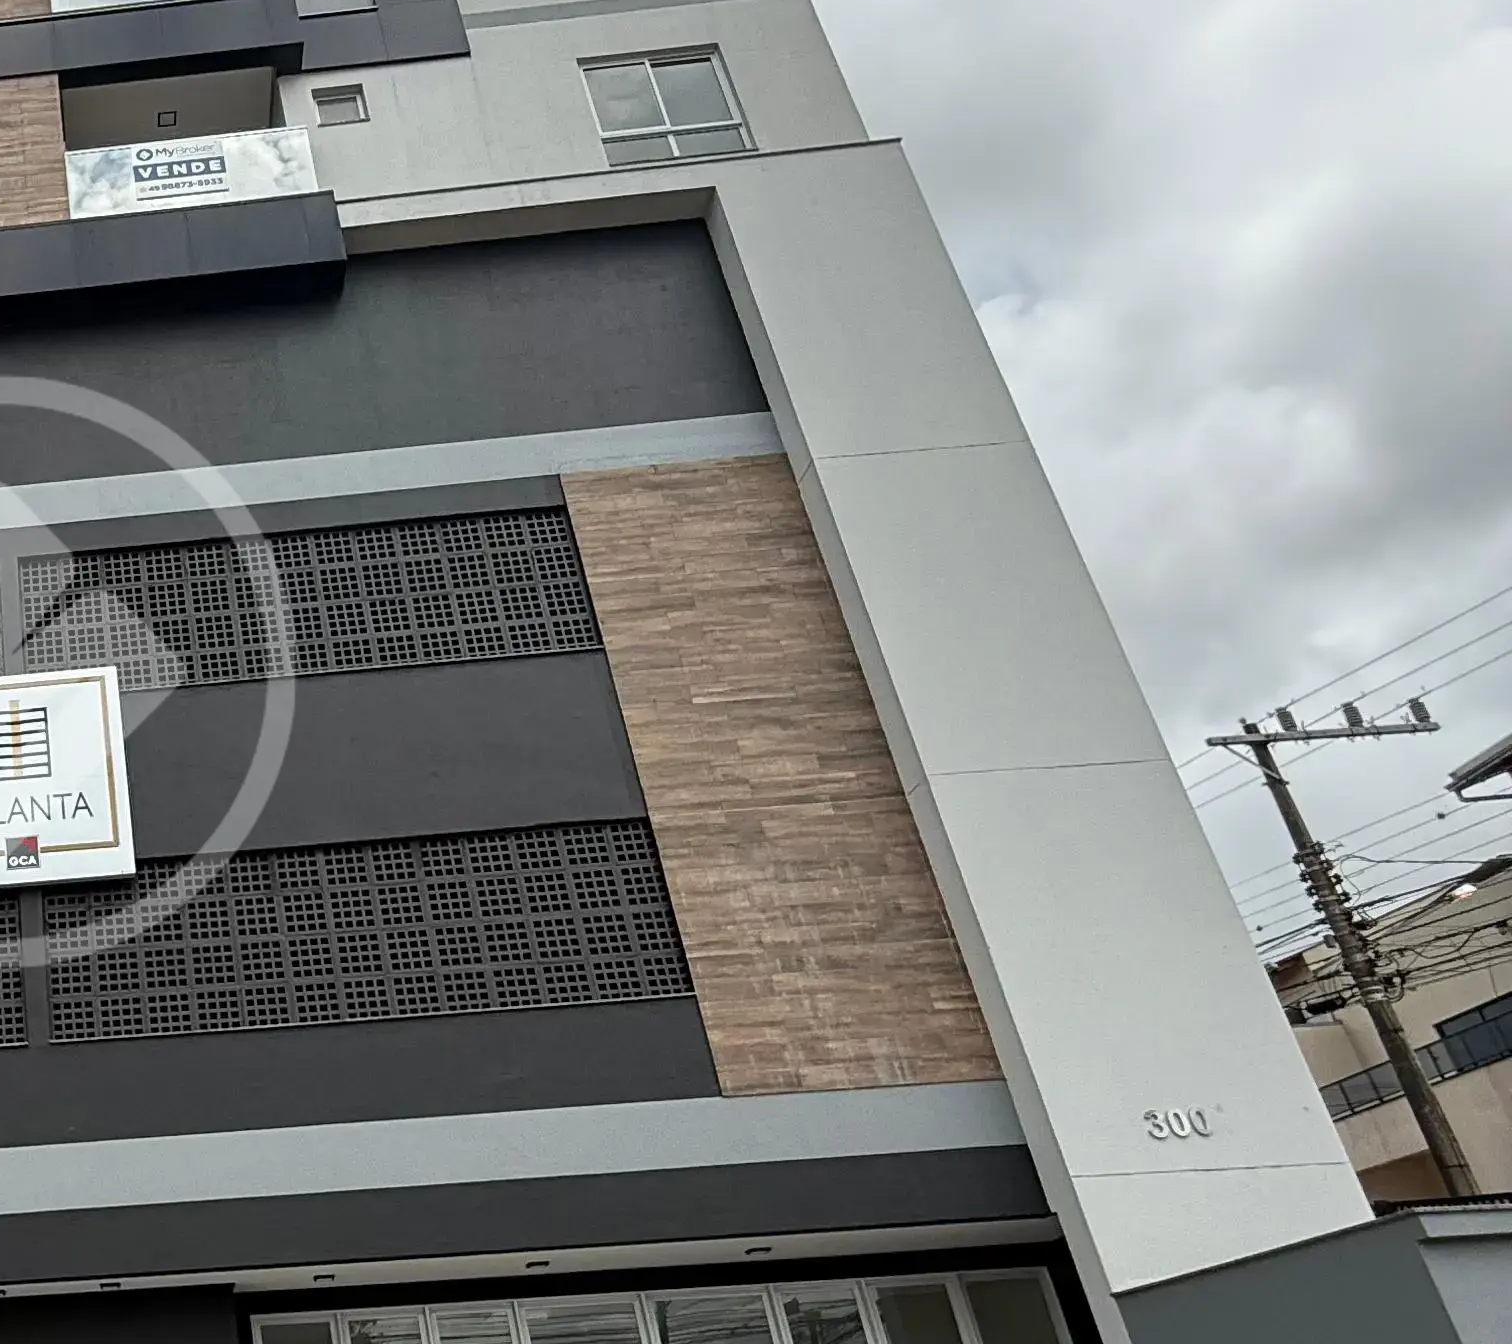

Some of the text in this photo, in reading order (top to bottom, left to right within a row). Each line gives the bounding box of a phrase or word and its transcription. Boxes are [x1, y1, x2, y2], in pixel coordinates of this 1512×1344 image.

[156, 142, 215, 158] MyBroker
[138, 158, 223, 179] VENDE
[8, 855, 38, 867] GCA
[1143, 1107, 1212, 1140] 300
